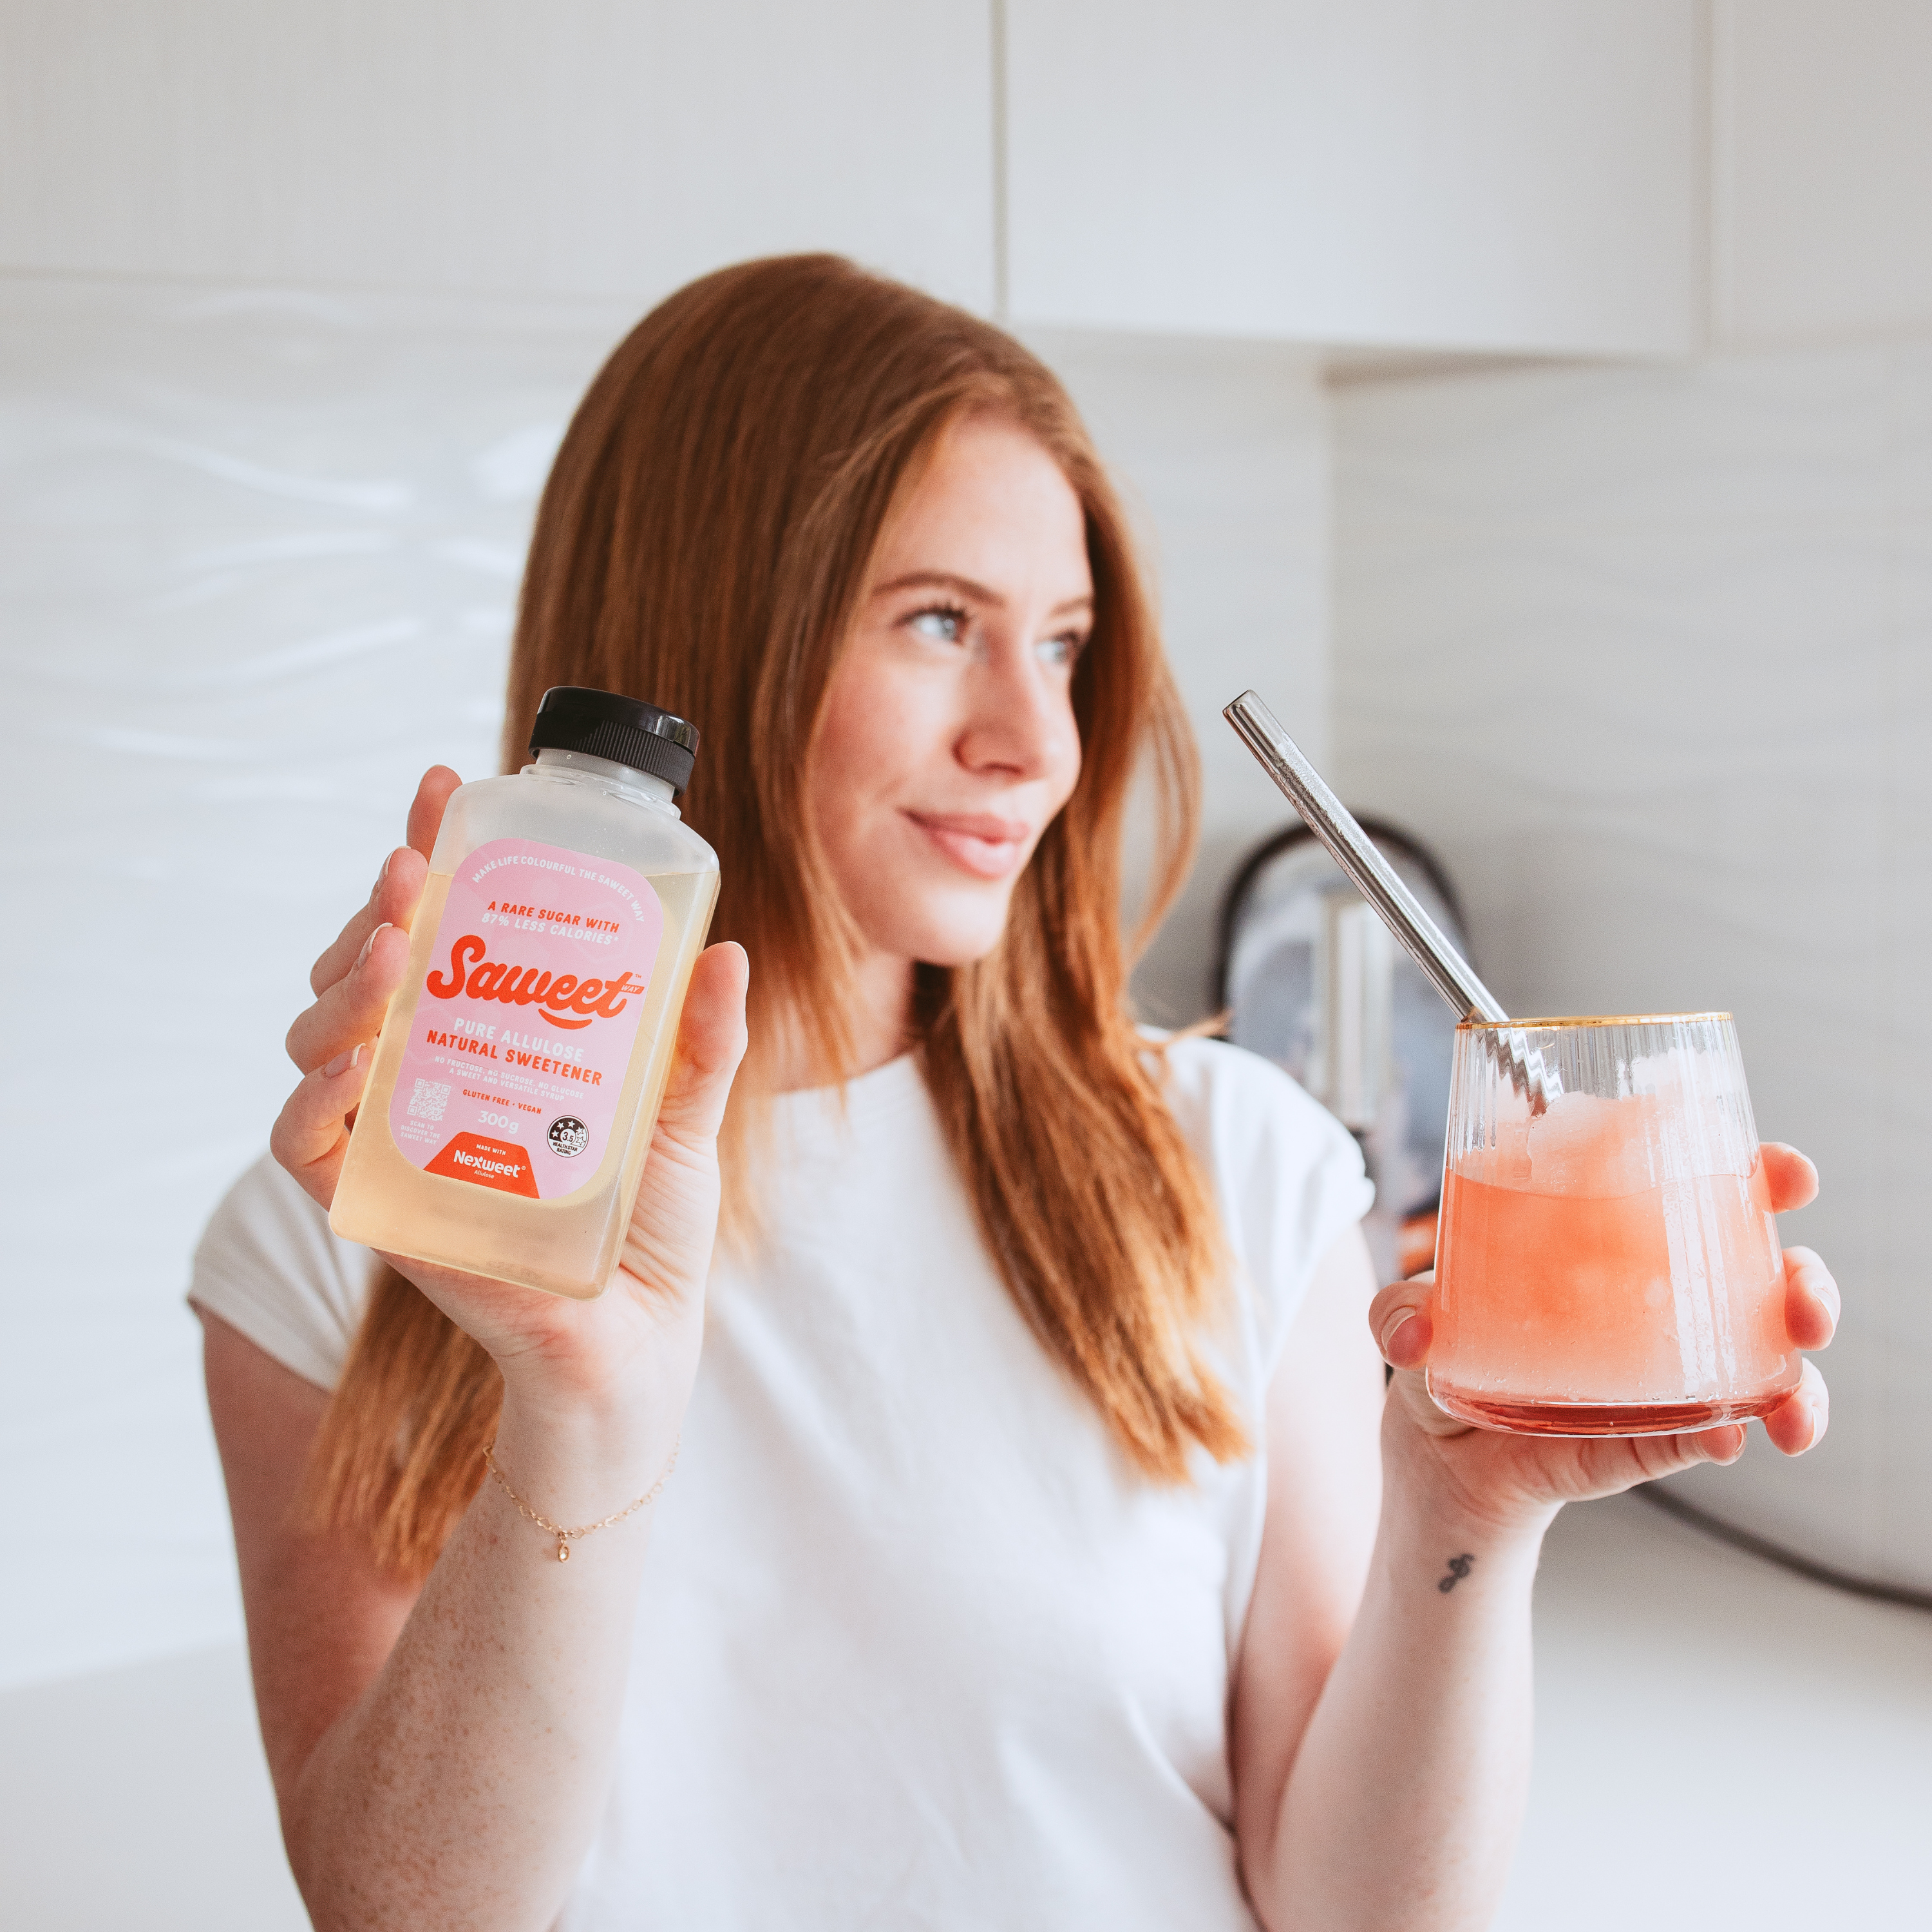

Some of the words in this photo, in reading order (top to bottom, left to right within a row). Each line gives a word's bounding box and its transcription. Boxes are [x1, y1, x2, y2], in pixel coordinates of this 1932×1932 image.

[472, 860, 497, 883] MAKE
[498, 856, 518, 867] LIFE
[521, 857, 576, 875] COLOURFUL
[580, 869, 596, 881] THE
[598, 875, 634, 900] SAWEET
[630, 900, 644, 922] WAY
[482, 913, 509, 927] 87%
[515, 918, 545, 933] LESS
[488, 901, 496, 911] A
[501, 902, 535, 917] RARE
[538, 909, 581, 925] SUGAR
[586, 918, 620, 933] WITH
[427, 934, 633, 1018] Saweet
[454, 1018, 496, 1039] PURE
[501, 1030, 584, 1063] ALLULOSE
[427, 1030, 498, 1059] NATURAL
[506, 1049, 602, 1086] SWEETENER
[457, 1070, 481, 1081] SWEET
[483, 1075, 497, 1084] AND
[500, 1080, 538, 1094] VERSATILE
[540, 1090, 564, 1101] SYRUP
[551, 1085, 584, 1099] GLUCOSE
[462, 1089, 490, 1101] GLUTEN
[492, 1097, 510, 1106] FREE
[518, 1103, 542, 1113] VEGAN
[401, 1125, 428, 1136] DISCOVER
[401, 1133, 422, 1142] SAWEET
[562, 1132, 573, 1142] 3.5
[474, 1170, 495, 1178] Allulose
